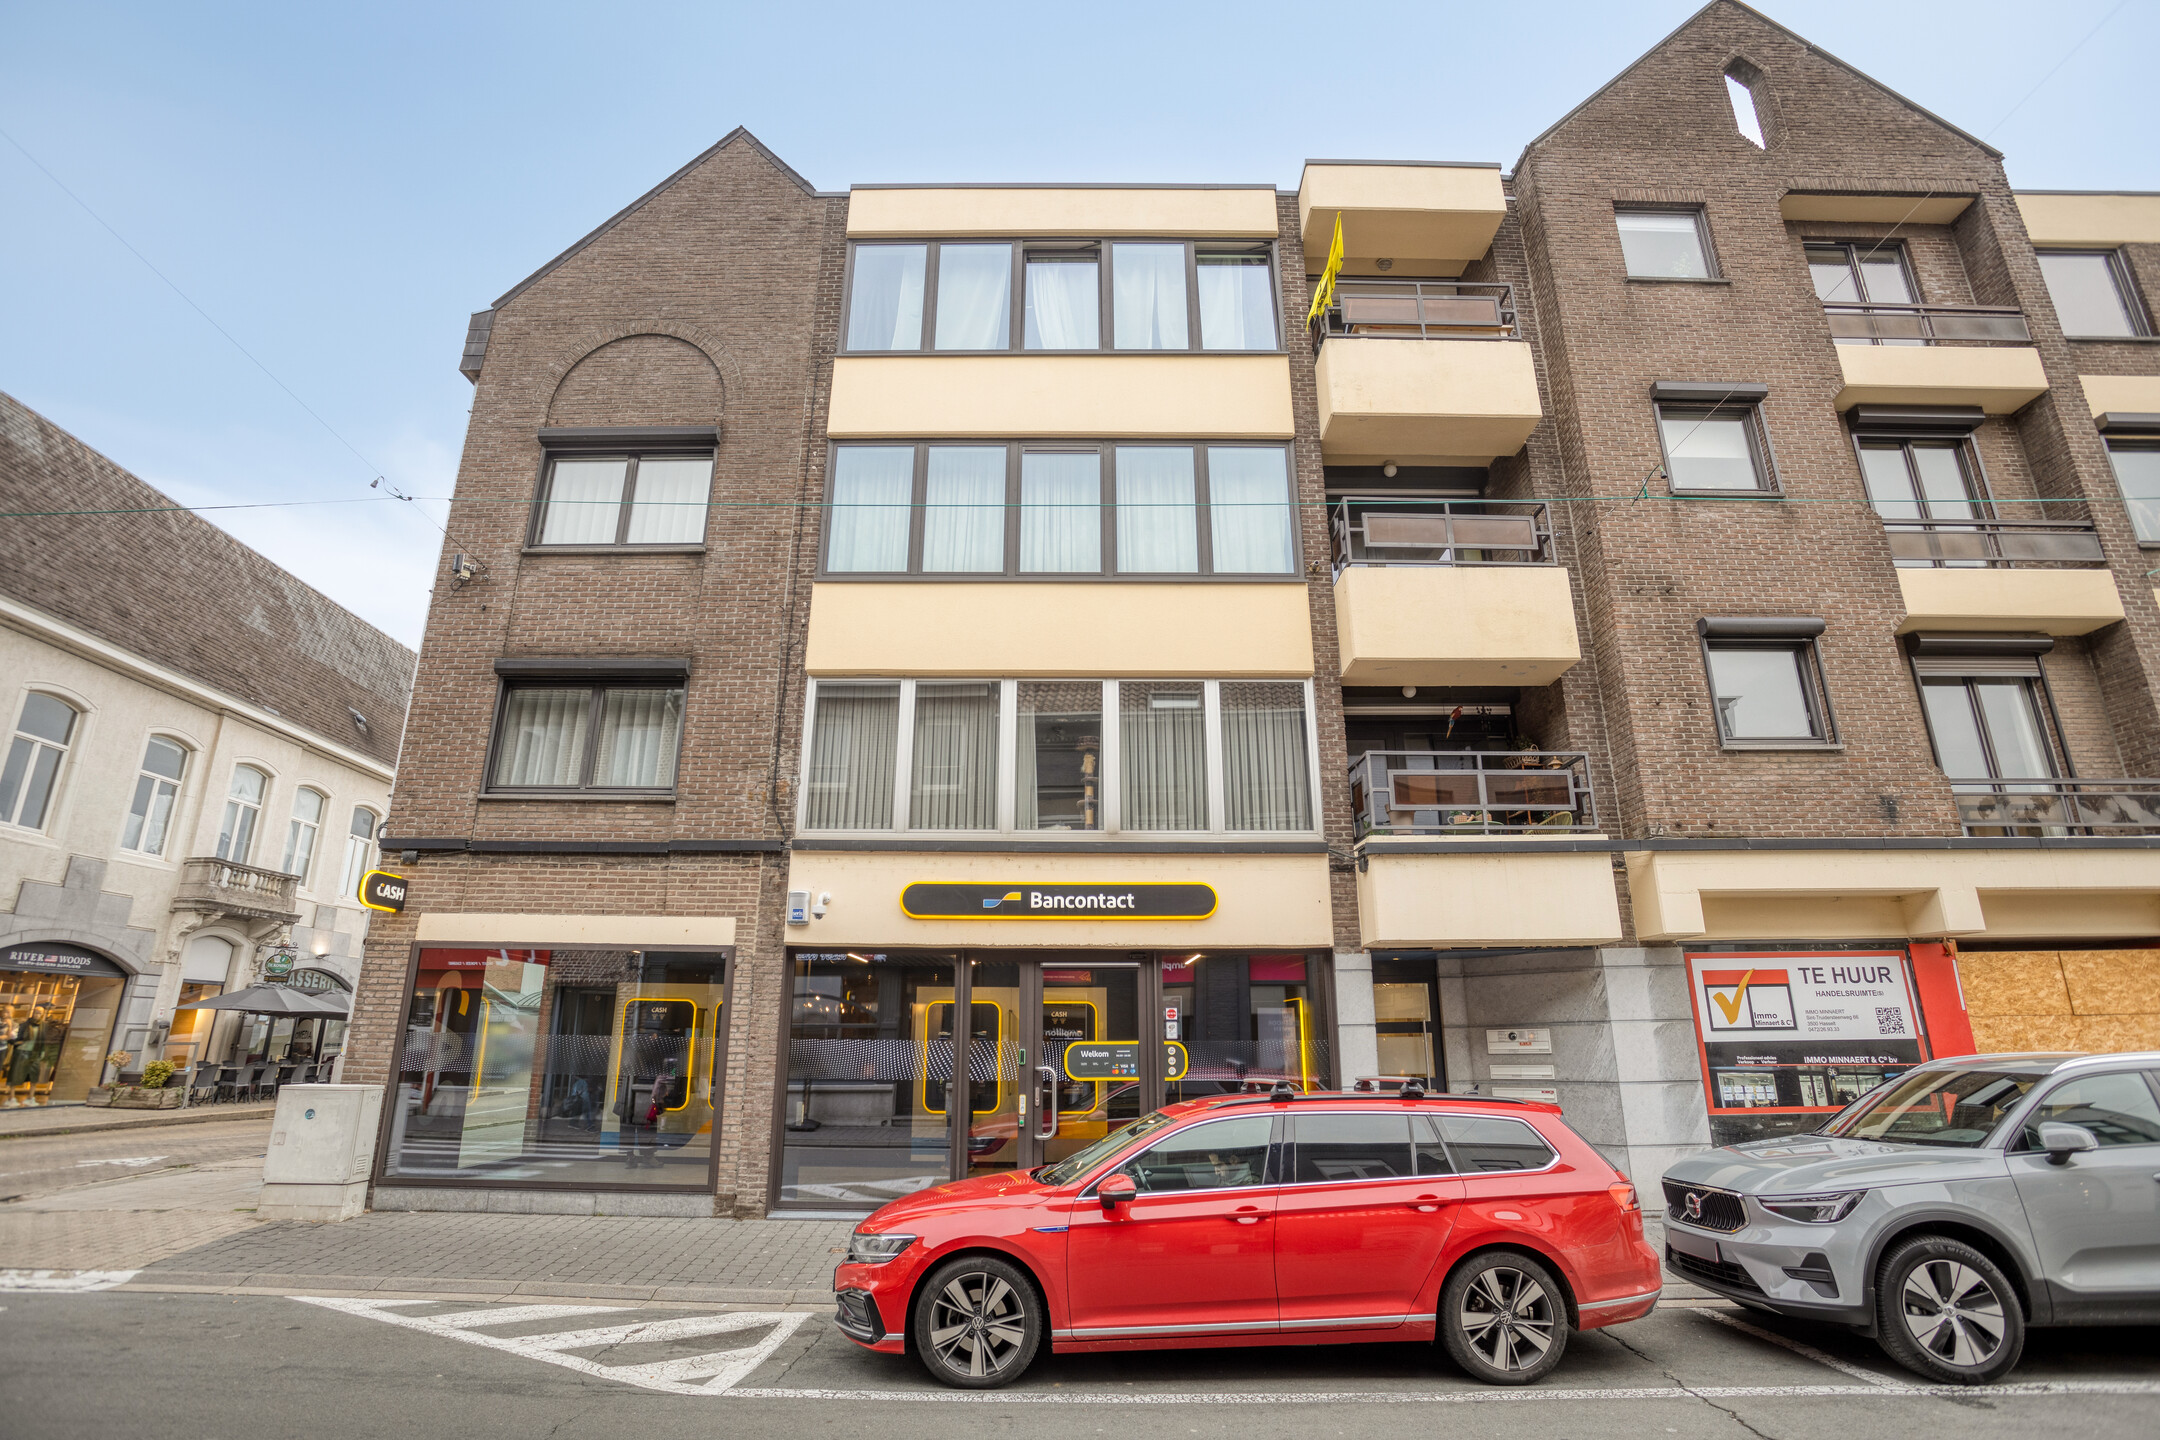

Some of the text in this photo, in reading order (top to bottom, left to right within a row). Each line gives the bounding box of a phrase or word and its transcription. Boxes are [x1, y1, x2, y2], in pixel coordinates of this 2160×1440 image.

[376, 882, 405, 901] CASH
[1030, 891, 1135, 909] Bancontact
[9, 951, 92, 965] RIVER WOODS
[1797, 966, 1893, 985] TE HUUR
[1753, 1011, 1778, 1020] Immo
[1080, 1050, 1109, 1058] Welkom
[1804, 1056, 1827, 1064] IMMO
